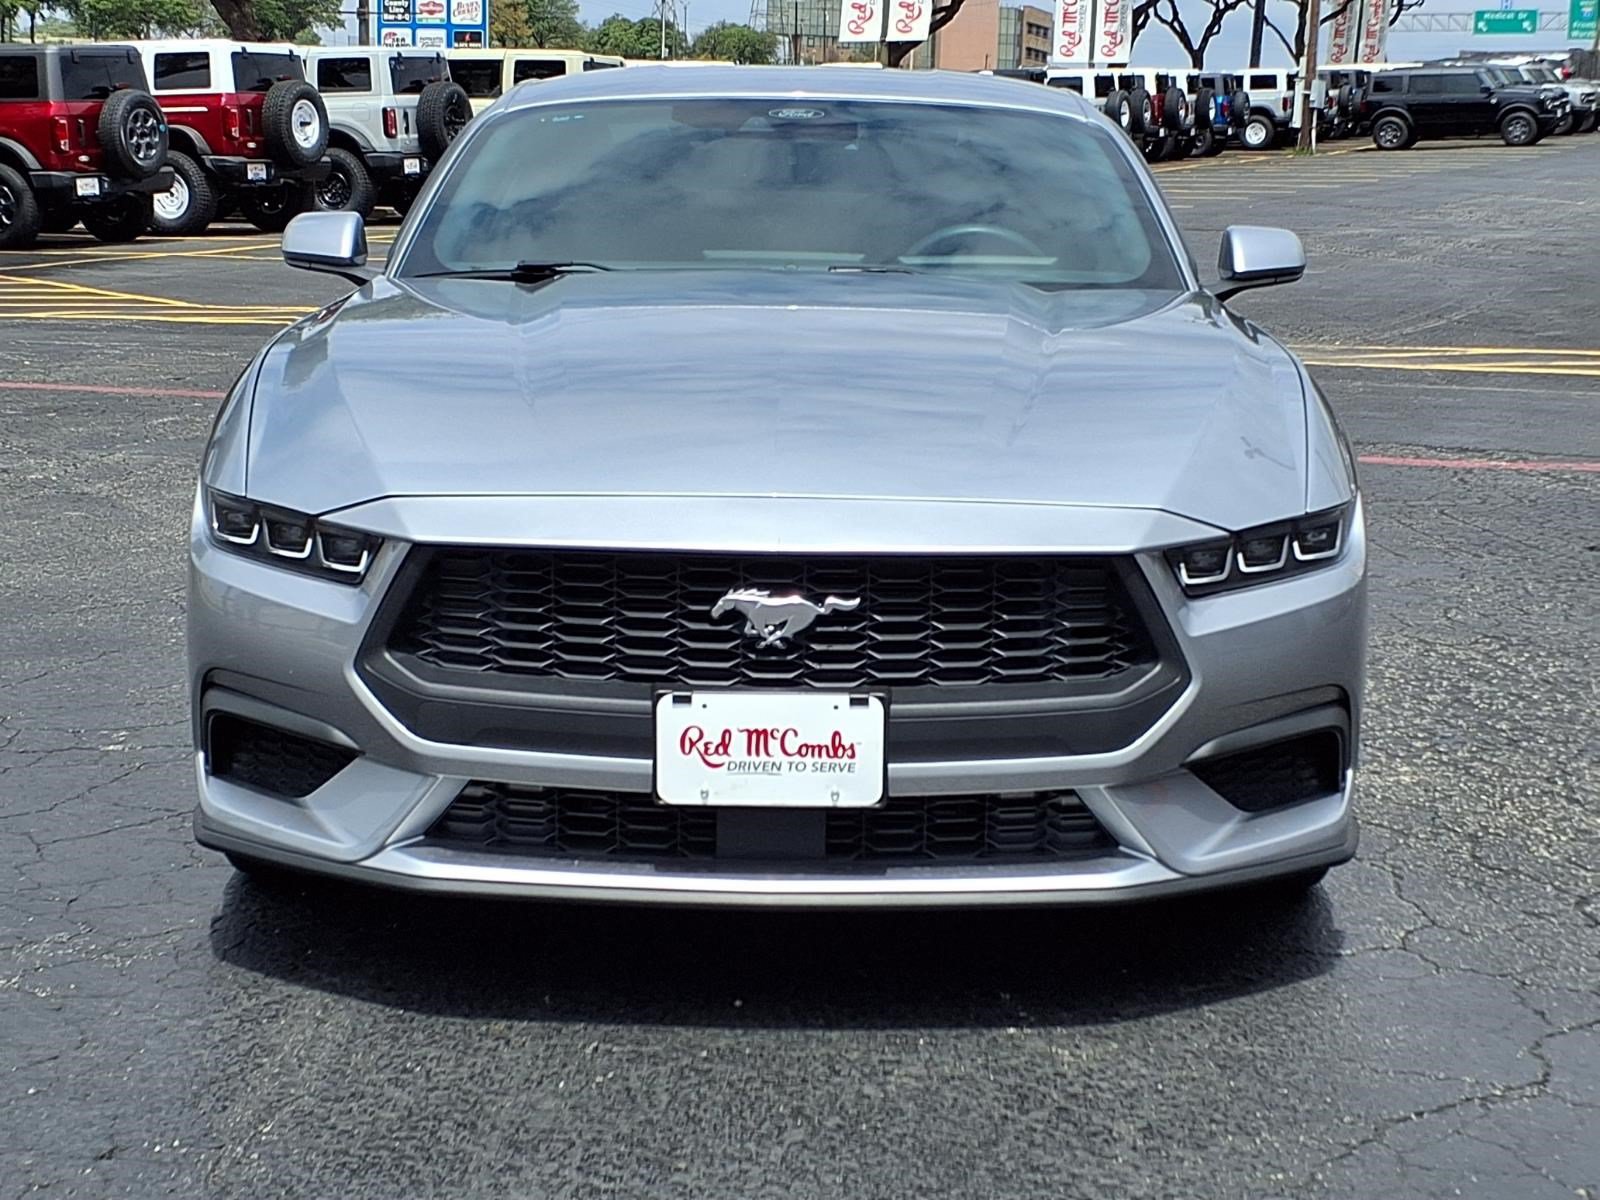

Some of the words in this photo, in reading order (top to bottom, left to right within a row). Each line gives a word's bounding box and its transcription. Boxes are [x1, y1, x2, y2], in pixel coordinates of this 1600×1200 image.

[848, 2, 874, 34] Red
[896, 1, 922, 33] Red
[1483, 12, 1515, 20] Medical
[1517, 12, 1529, 20] Dr
[1059, 31, 1082, 57] Red
[1101, 31, 1123, 57] Red
[778, 108, 815, 118] Ford
[680, 726, 733, 768] Red
[737, 728, 856, 759] McCombs
[727, 760, 782, 772] DRIVEN
[787, 761, 807, 772] TO
[811, 762, 856, 773] SERVE
